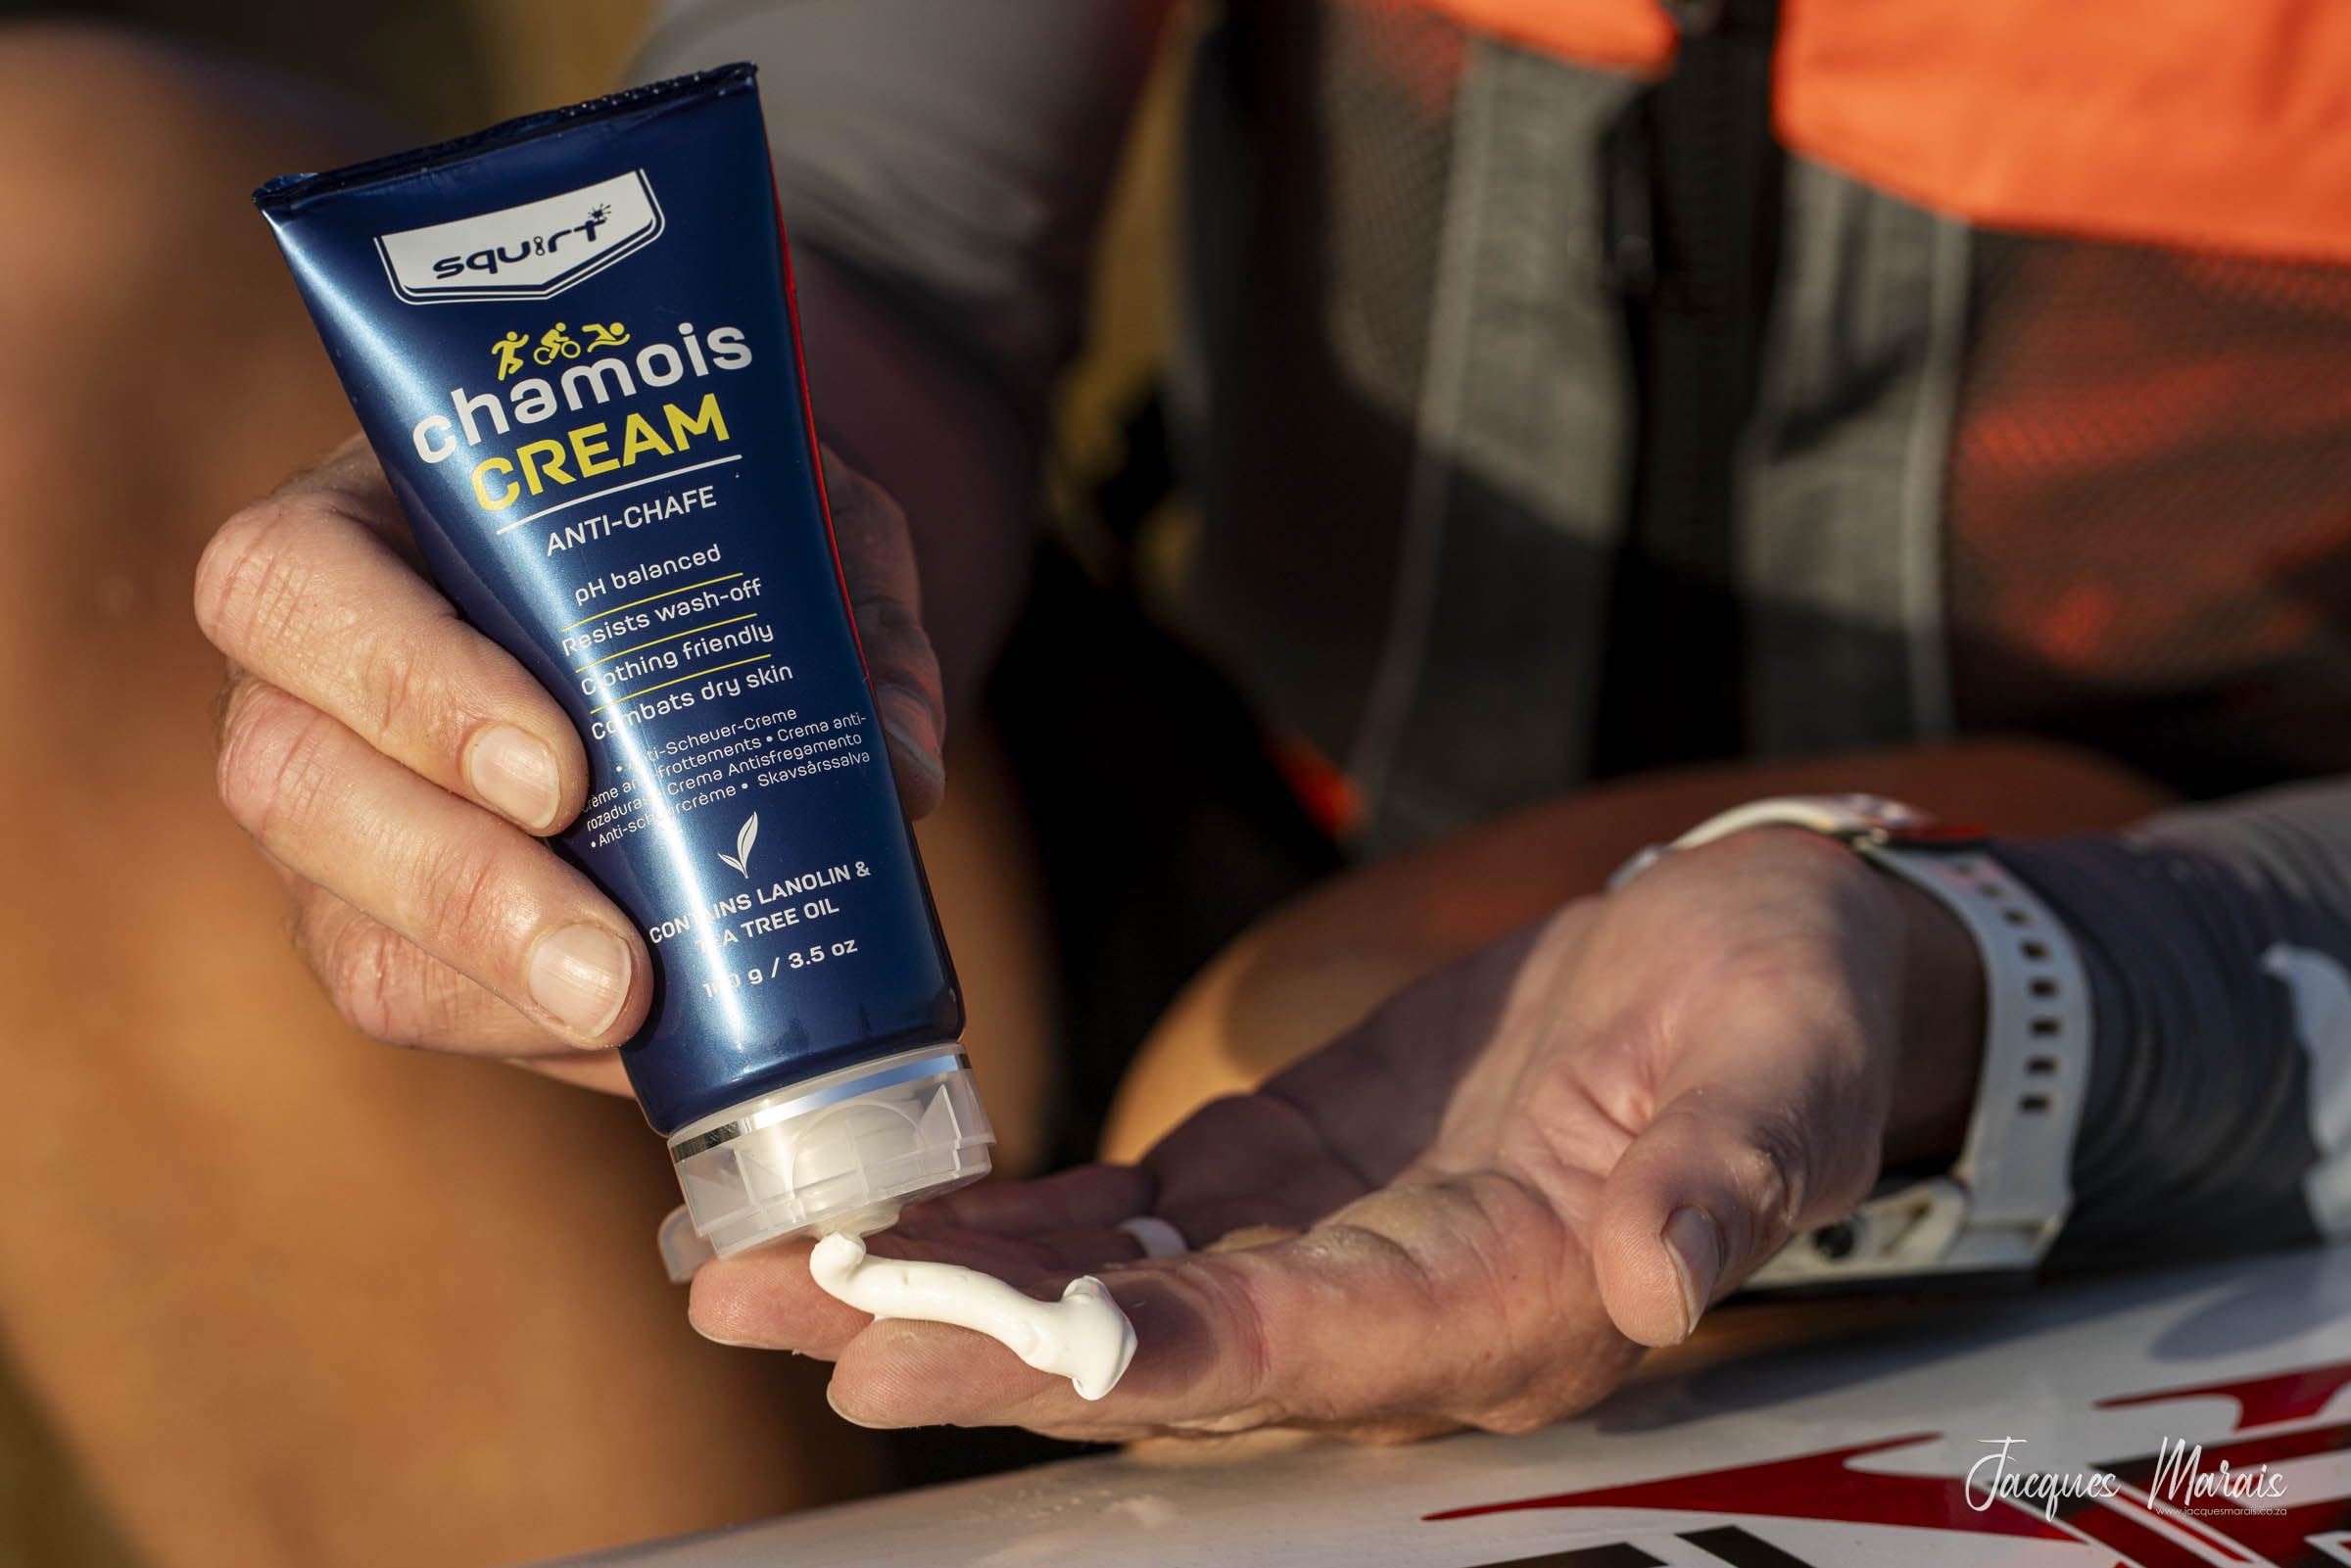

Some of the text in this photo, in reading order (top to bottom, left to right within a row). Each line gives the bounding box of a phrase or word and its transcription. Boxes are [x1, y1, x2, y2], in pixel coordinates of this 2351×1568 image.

[433, 208, 609, 279] squirt
[411, 321, 753, 465] chamois
[469, 393, 731, 513] CREAM
[546, 484, 718, 557] ANTI-CHAFE
[575, 543, 722, 606] pH balanced
[561, 577, 763, 656] Resists wash-off
[682, 622, 775, 662] friendly
[700, 676, 742, 704] dry
[745, 662, 794, 689] skin
[621, 735, 762, 794] an-frottements
[777, 721, 830, 742] Crema
[833, 712, 868, 730] anti-
[628, 707, 798, 771] ti-Scheuer-Creme
[667, 770, 724, 796] Crema
[728, 733, 863, 777] Antisfregamento
[599, 749, 871, 847] Anti-schrcrème Skavsårssalva
[756, 865, 851, 906] LANOLIN
[854, 861, 871, 878] &
[695, 897, 840, 956] TA TREE OIL
[702, 938, 859, 999] 10 g / 3.5 oz
